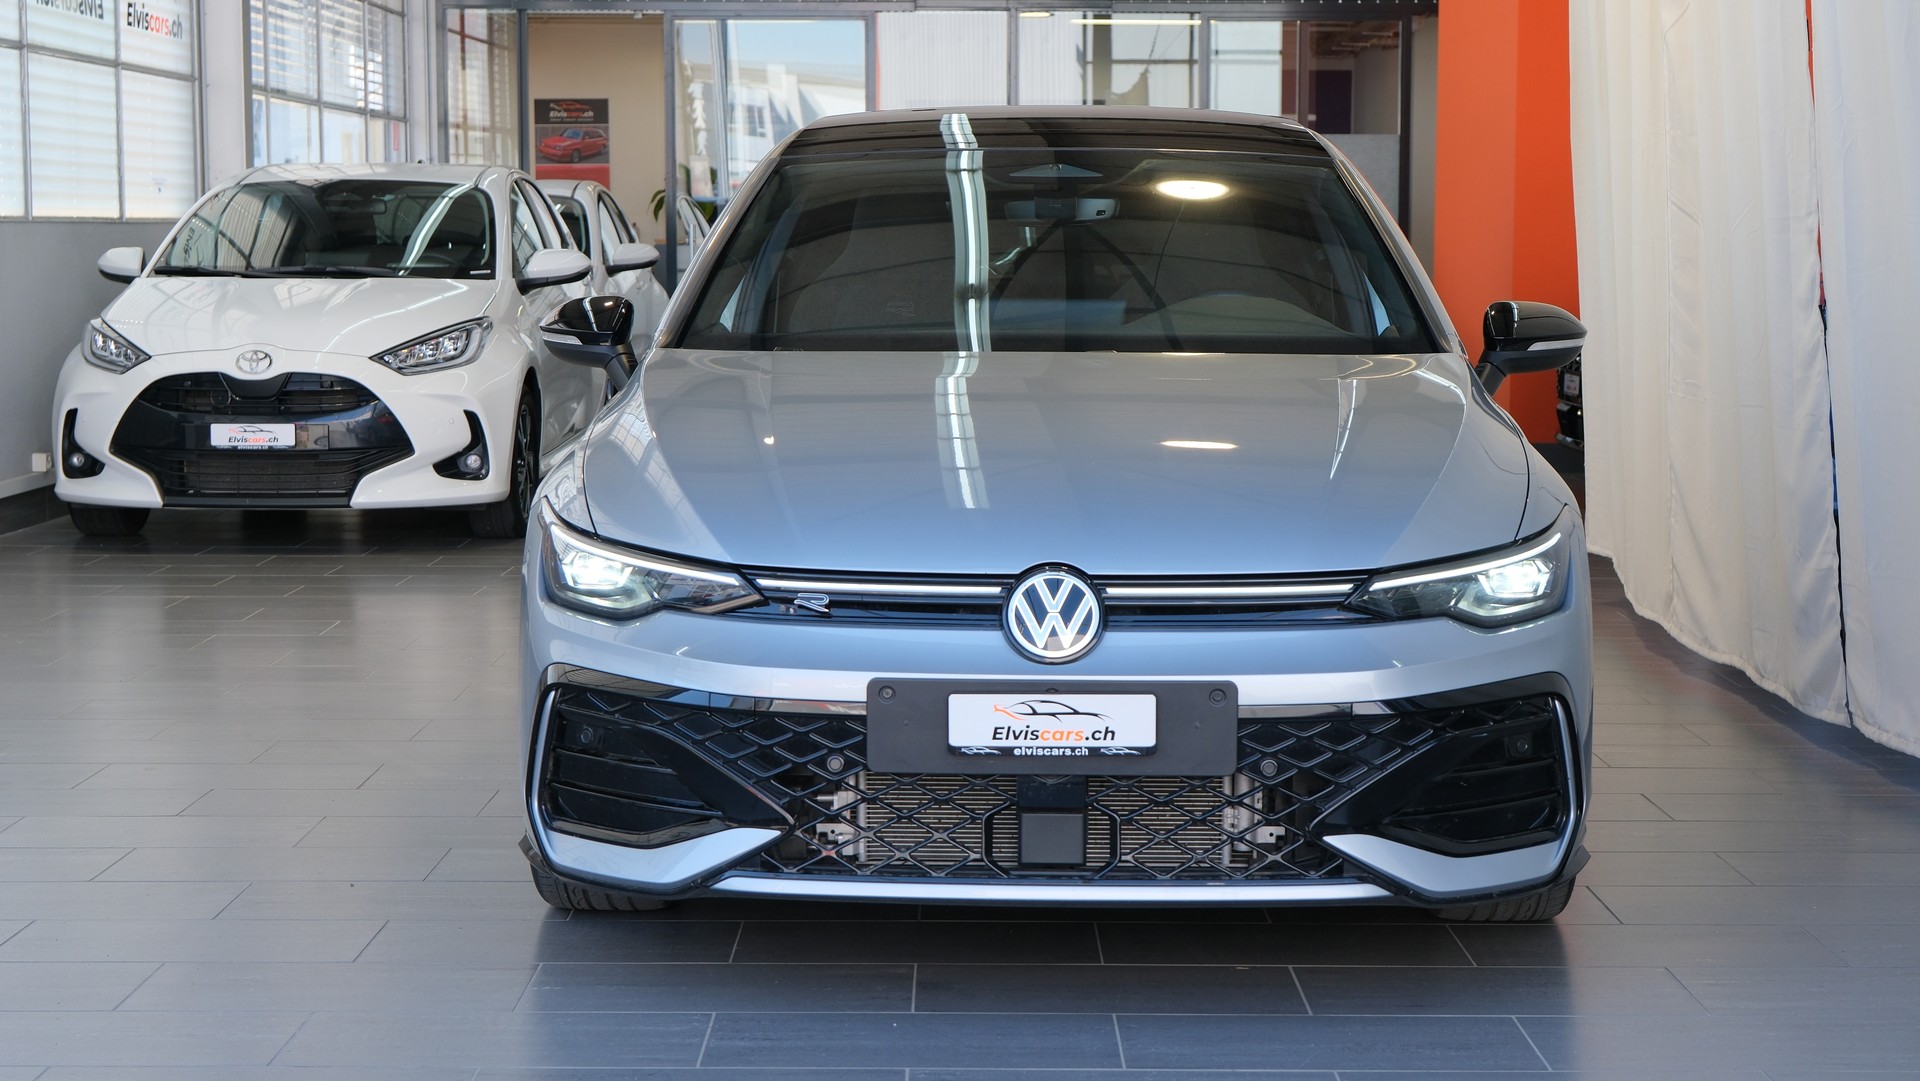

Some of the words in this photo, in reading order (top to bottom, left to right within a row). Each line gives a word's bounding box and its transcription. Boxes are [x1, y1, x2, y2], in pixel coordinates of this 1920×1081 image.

[127, 2, 182, 39] Elviscars.ch
[793, 592, 830, 613] R
[1013, 576, 1096, 651] VW
[991, 725, 1116, 742] Elviscars.ch
[1013, 746, 1089, 757] elviscars.ch
